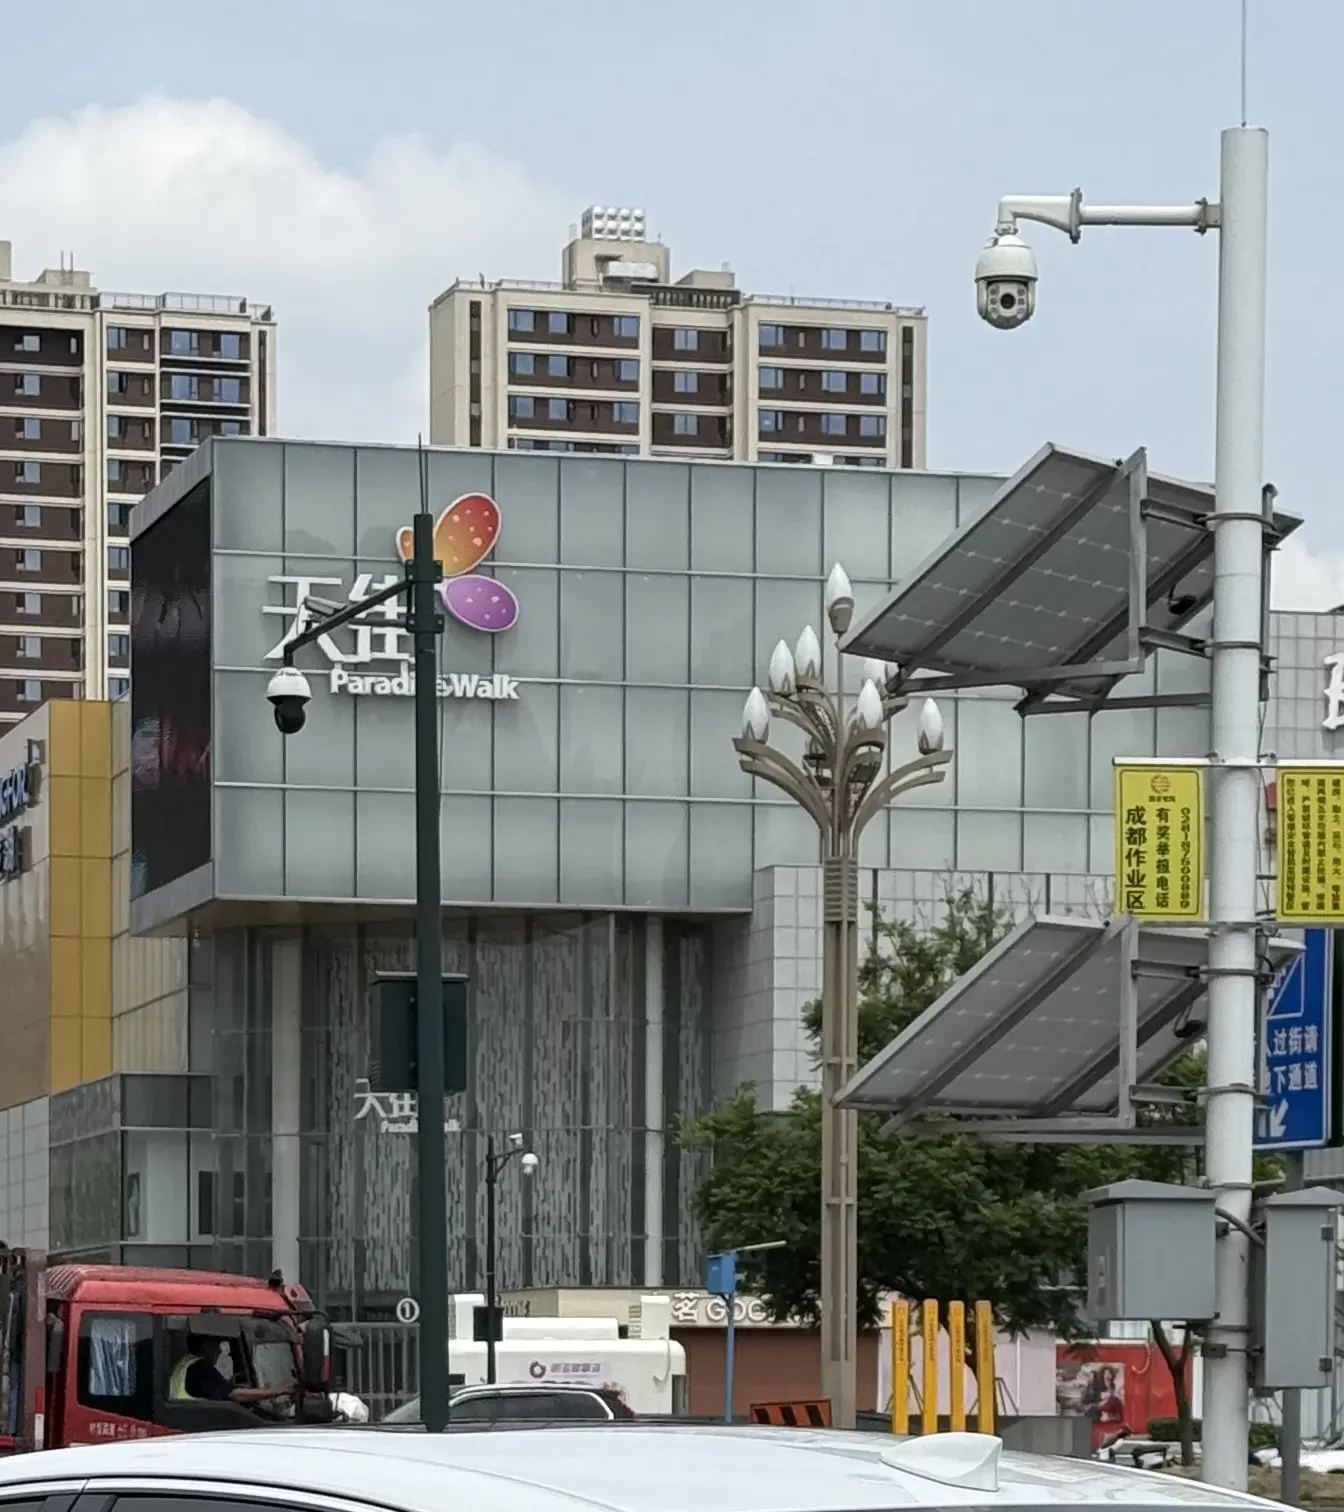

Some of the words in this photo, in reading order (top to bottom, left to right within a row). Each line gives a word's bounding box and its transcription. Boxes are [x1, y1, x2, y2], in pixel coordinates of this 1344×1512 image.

[1125, 805, 1147, 910] 成都作业区
[1267, 1024, 1318, 1057] 过街请
